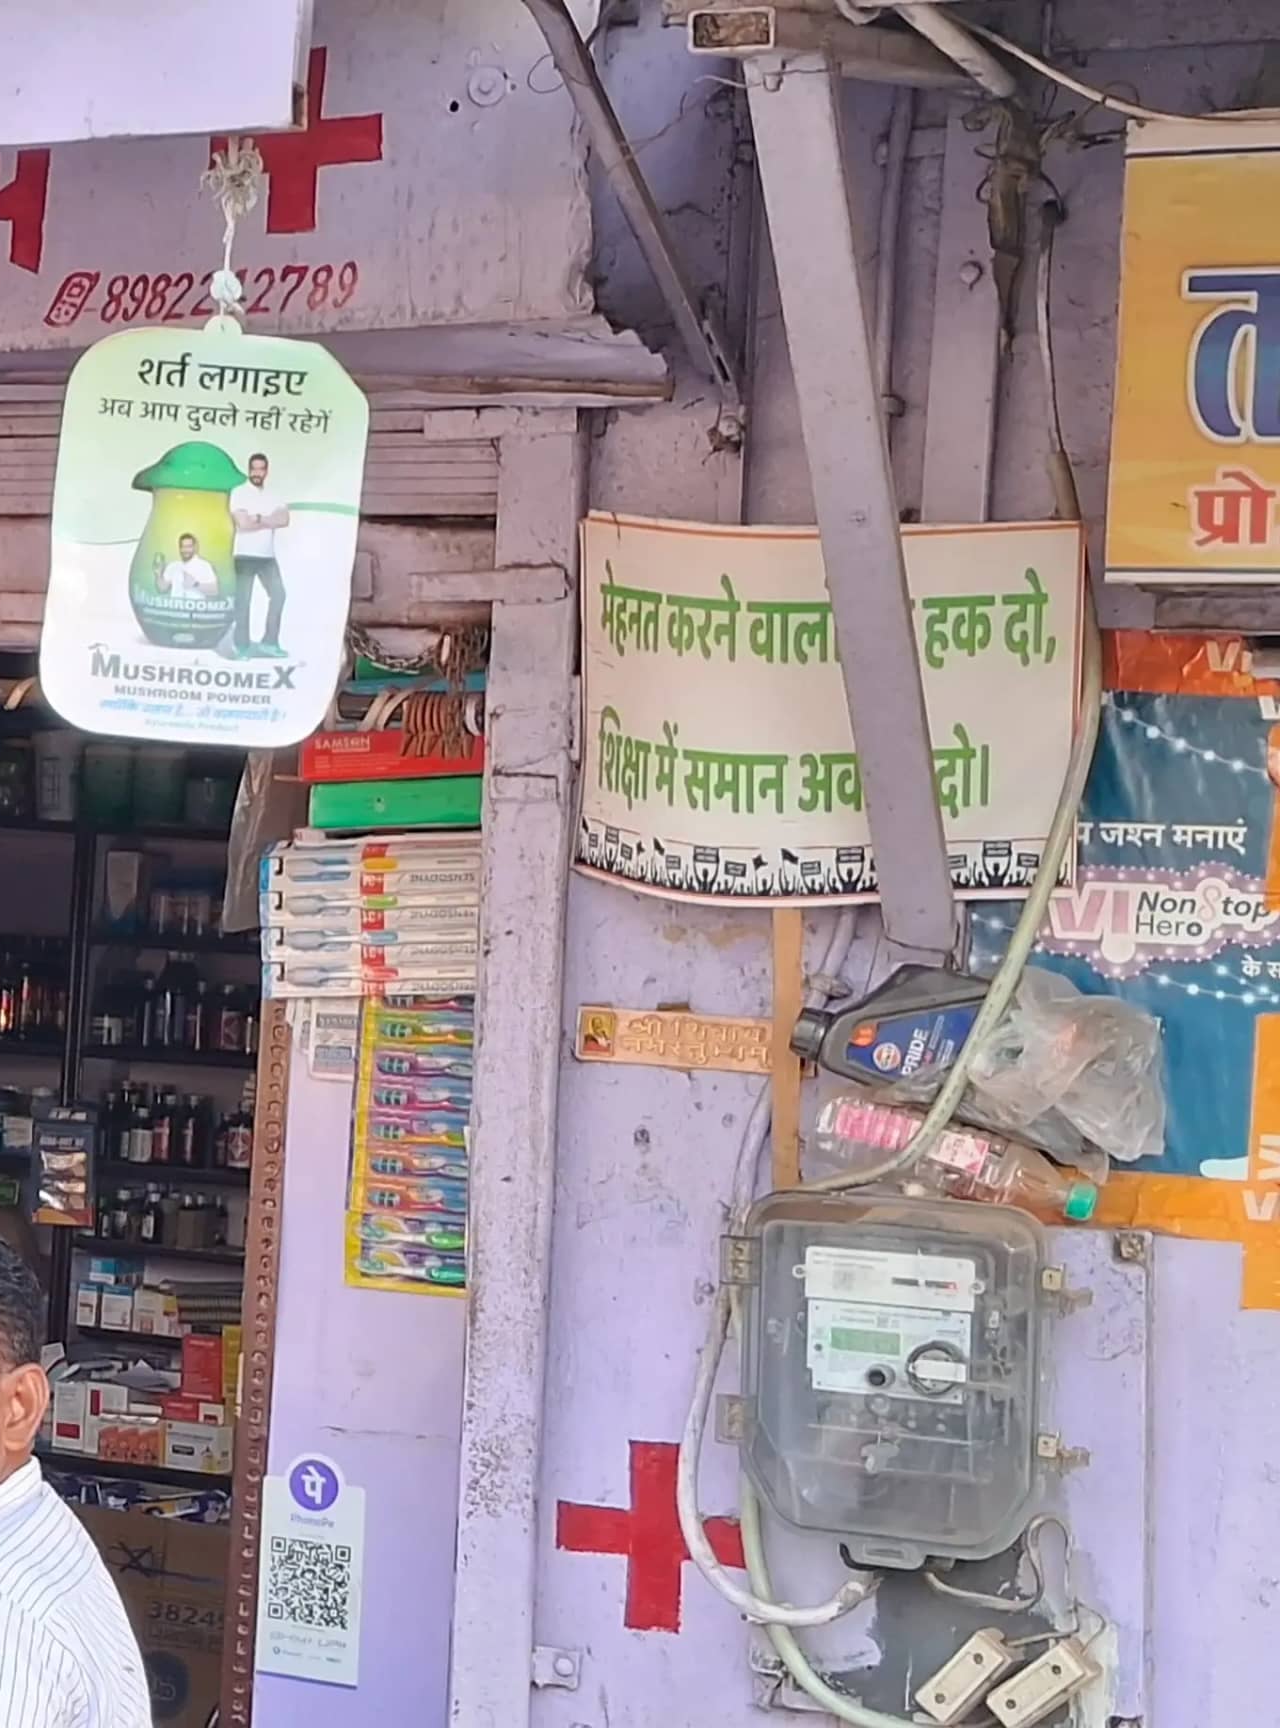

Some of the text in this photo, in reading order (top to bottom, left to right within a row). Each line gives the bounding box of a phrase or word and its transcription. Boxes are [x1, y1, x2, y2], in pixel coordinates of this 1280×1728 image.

[101, 261, 358, 324] 898222789
[138, 352, 308, 396] शर्त लगाइए
[98, 397, 130, 419] अब
[138, 400, 178, 422] आप
[187, 403, 239, 431] दुबले
[245, 406, 287, 431] नहीं
[600, 560, 663, 656] मेहनत
[667, 574, 741, 662] करने
[922, 595, 995, 668] हक
[114, 685, 271, 705] MUSHROOM POWDER
[599, 705, 652, 811] शिक्षा
[655, 720, 678, 806] में
[683, 749, 788, 813] समान
[1100, 822, 1166, 849] जश्न
[1172, 818, 1247, 854] मनाएं
[1136, 913, 1203, 937] Hero
[901, 1027, 930, 1076] PRIDE
